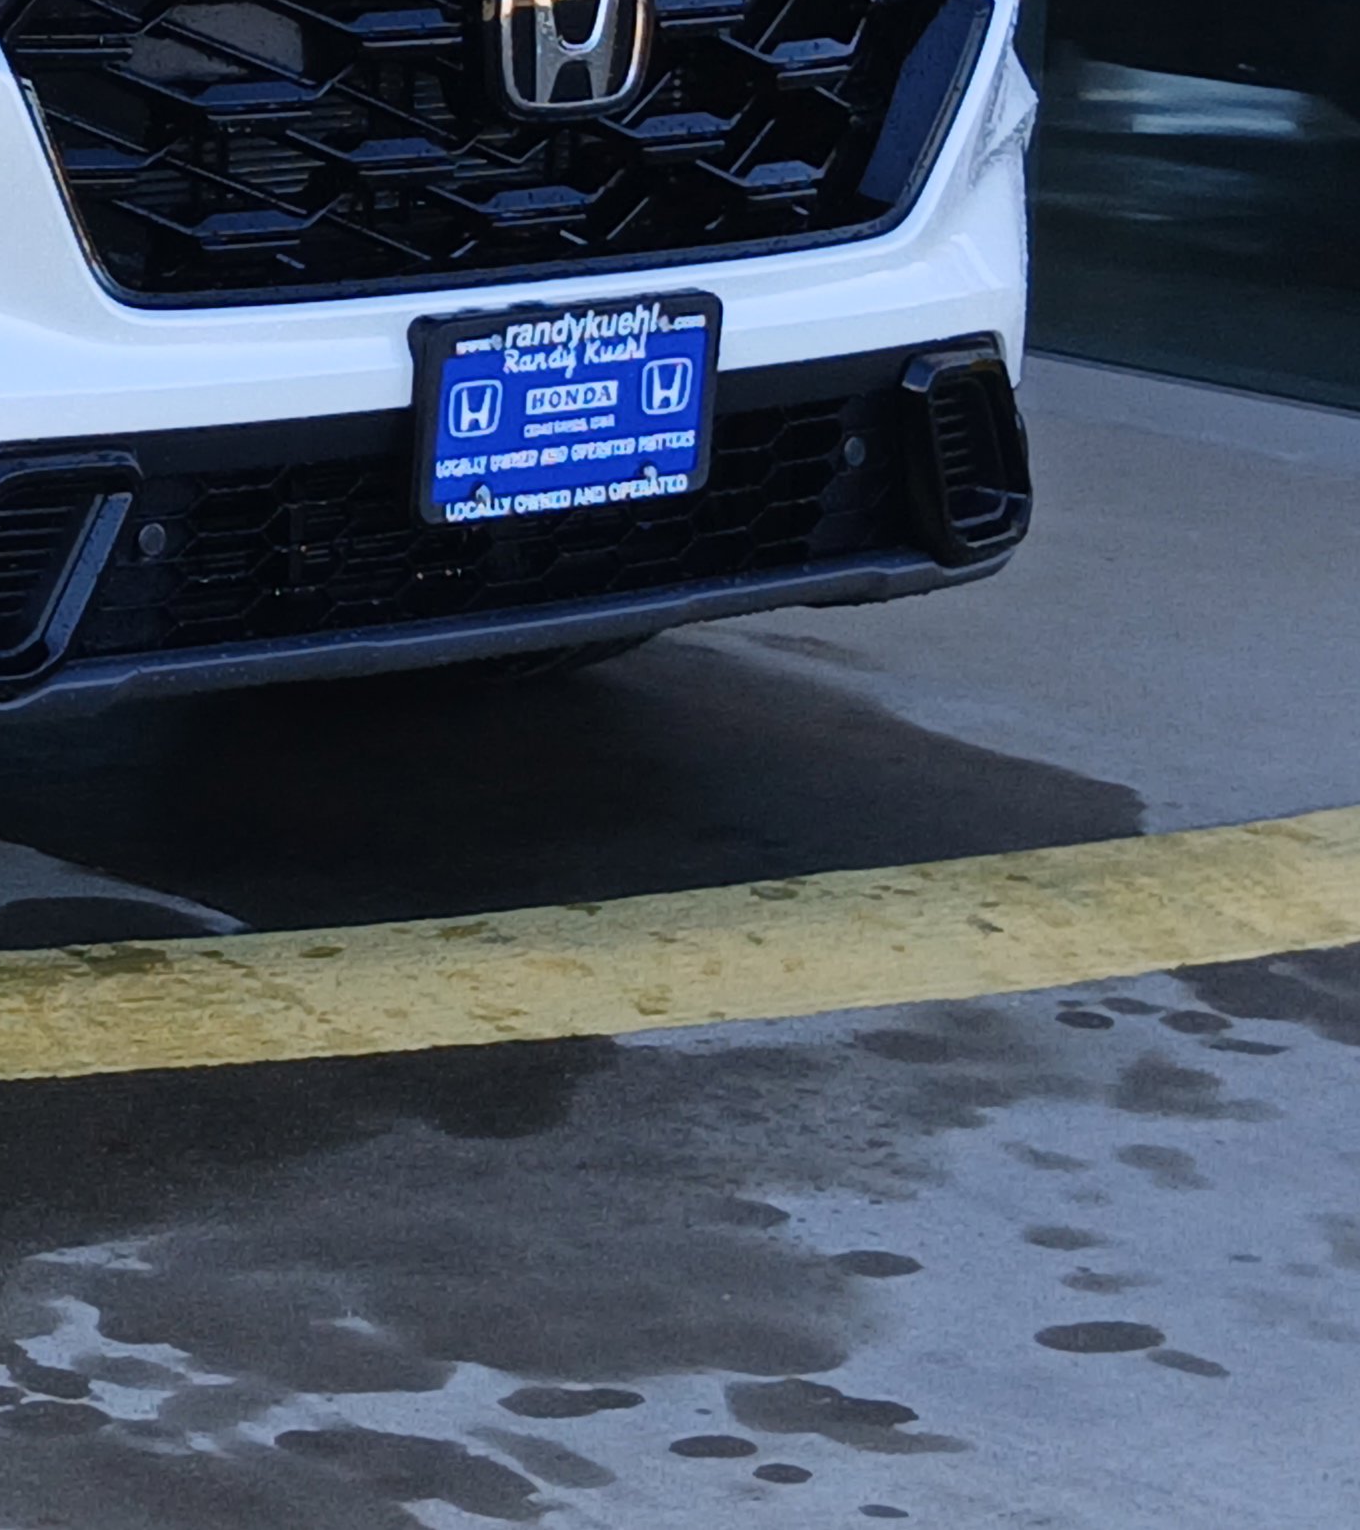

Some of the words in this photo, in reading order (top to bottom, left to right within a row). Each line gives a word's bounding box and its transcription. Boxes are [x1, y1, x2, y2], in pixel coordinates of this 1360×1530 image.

[503, 345, 577, 379] Randy
[584, 334, 647, 365] Kuehl
[531, 384, 612, 410] HONDA
[435, 455, 488, 478] LOCALLY
[446, 496, 512, 522] LOCALLY
[514, 489, 571, 514] OWNED
[574, 485, 606, 507] AND
[609, 474, 688, 502] OPERATED
